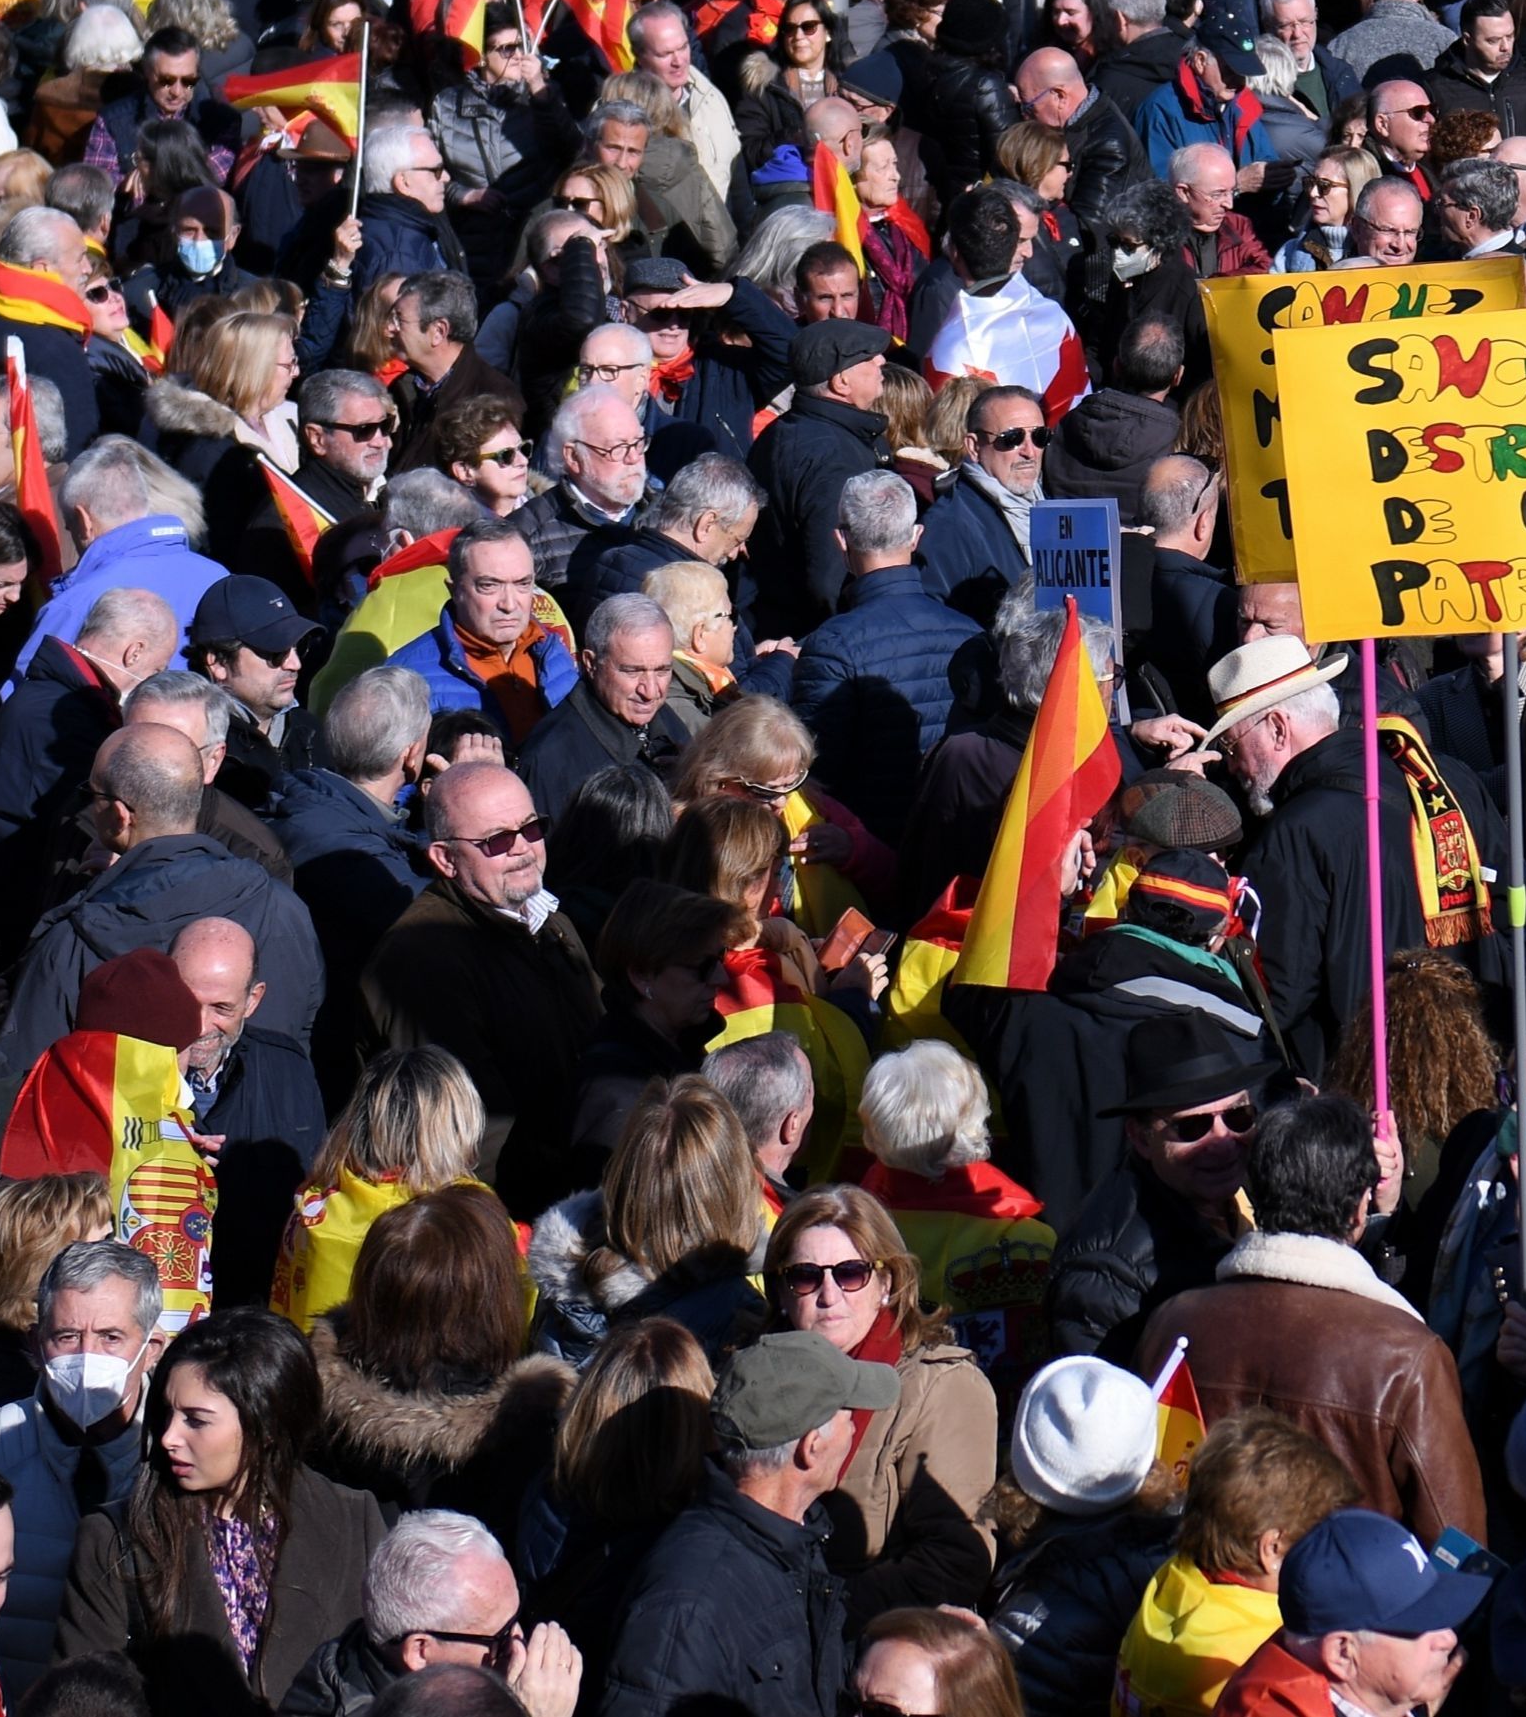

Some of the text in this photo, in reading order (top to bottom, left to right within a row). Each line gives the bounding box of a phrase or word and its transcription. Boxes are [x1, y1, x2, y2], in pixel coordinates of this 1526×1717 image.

[1059, 515, 1072, 539] EN
[1384, 496, 1457, 546] DE
[1035, 549, 1111, 588] ALICANTE
